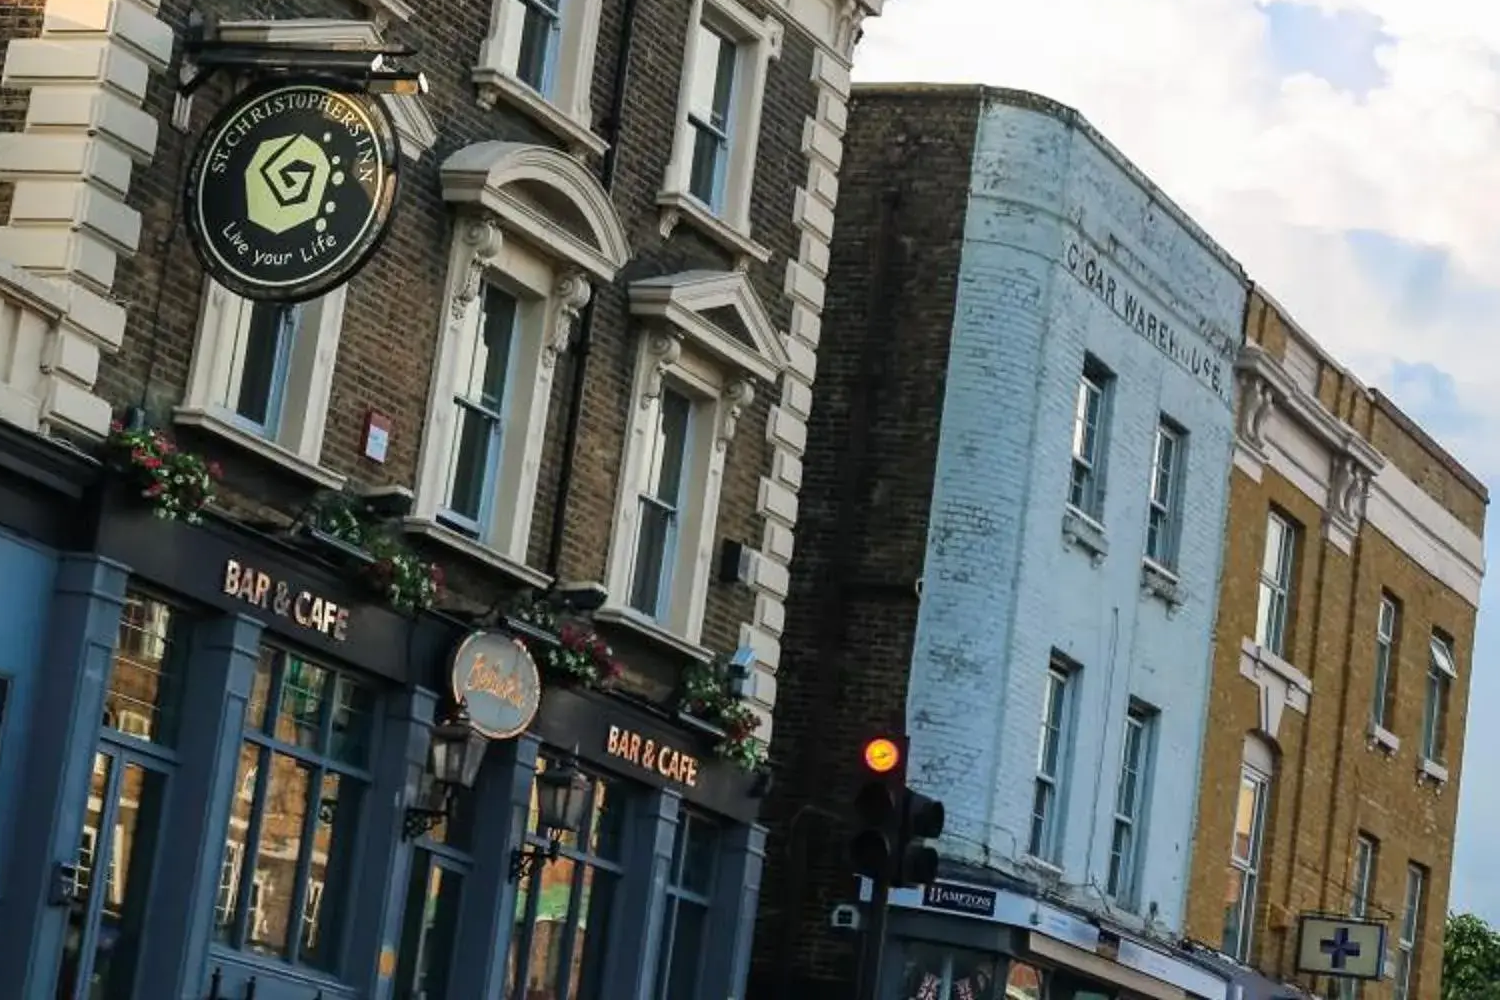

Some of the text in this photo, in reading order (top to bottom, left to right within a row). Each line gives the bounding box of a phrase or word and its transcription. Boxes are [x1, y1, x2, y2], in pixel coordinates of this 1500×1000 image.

[355, 137, 375, 183] INN
[221, 221, 337, 267] Live your Life
[224, 559, 350, 641] BAR & CAFE
[608, 725, 698, 787] BAR & CAFE
